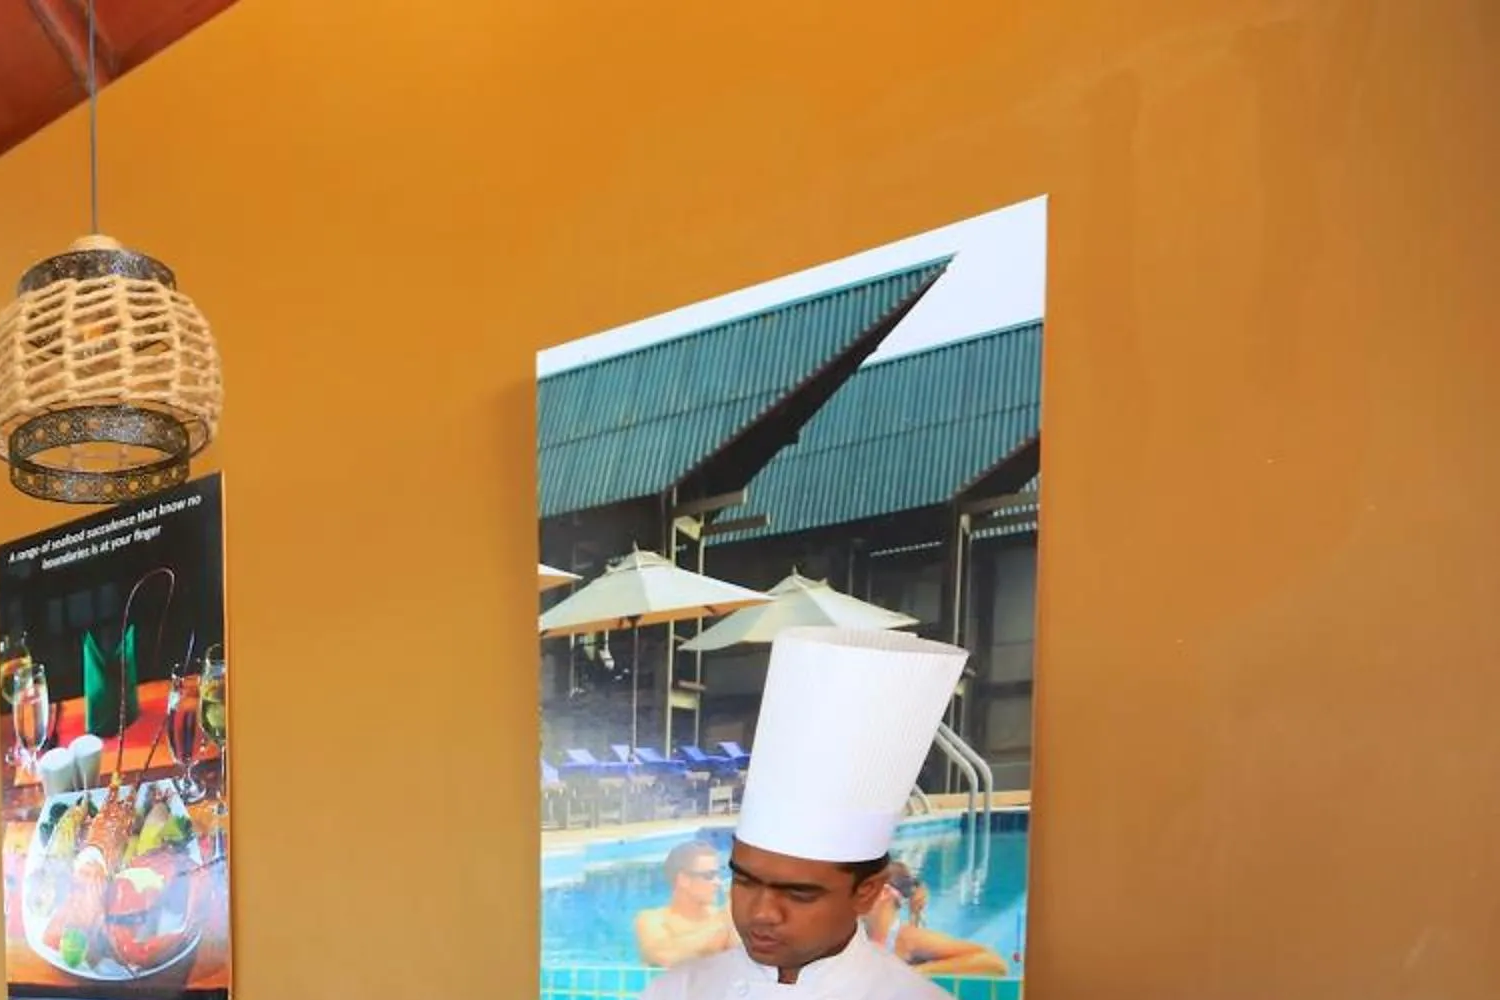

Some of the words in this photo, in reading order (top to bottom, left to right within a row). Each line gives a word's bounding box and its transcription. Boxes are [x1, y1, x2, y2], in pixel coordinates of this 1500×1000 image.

[16, 546, 40, 561] range
[41, 539, 51, 554] of
[51, 529, 85, 551] seafood
[137, 506, 158, 523] that
[158, 498, 187, 516] know
[187, 494, 202, 508] no
[41, 546, 90, 571] boundaries
[100, 539, 110, 554] at
[110, 533, 134, 552] your
[133, 525, 163, 542] finger
